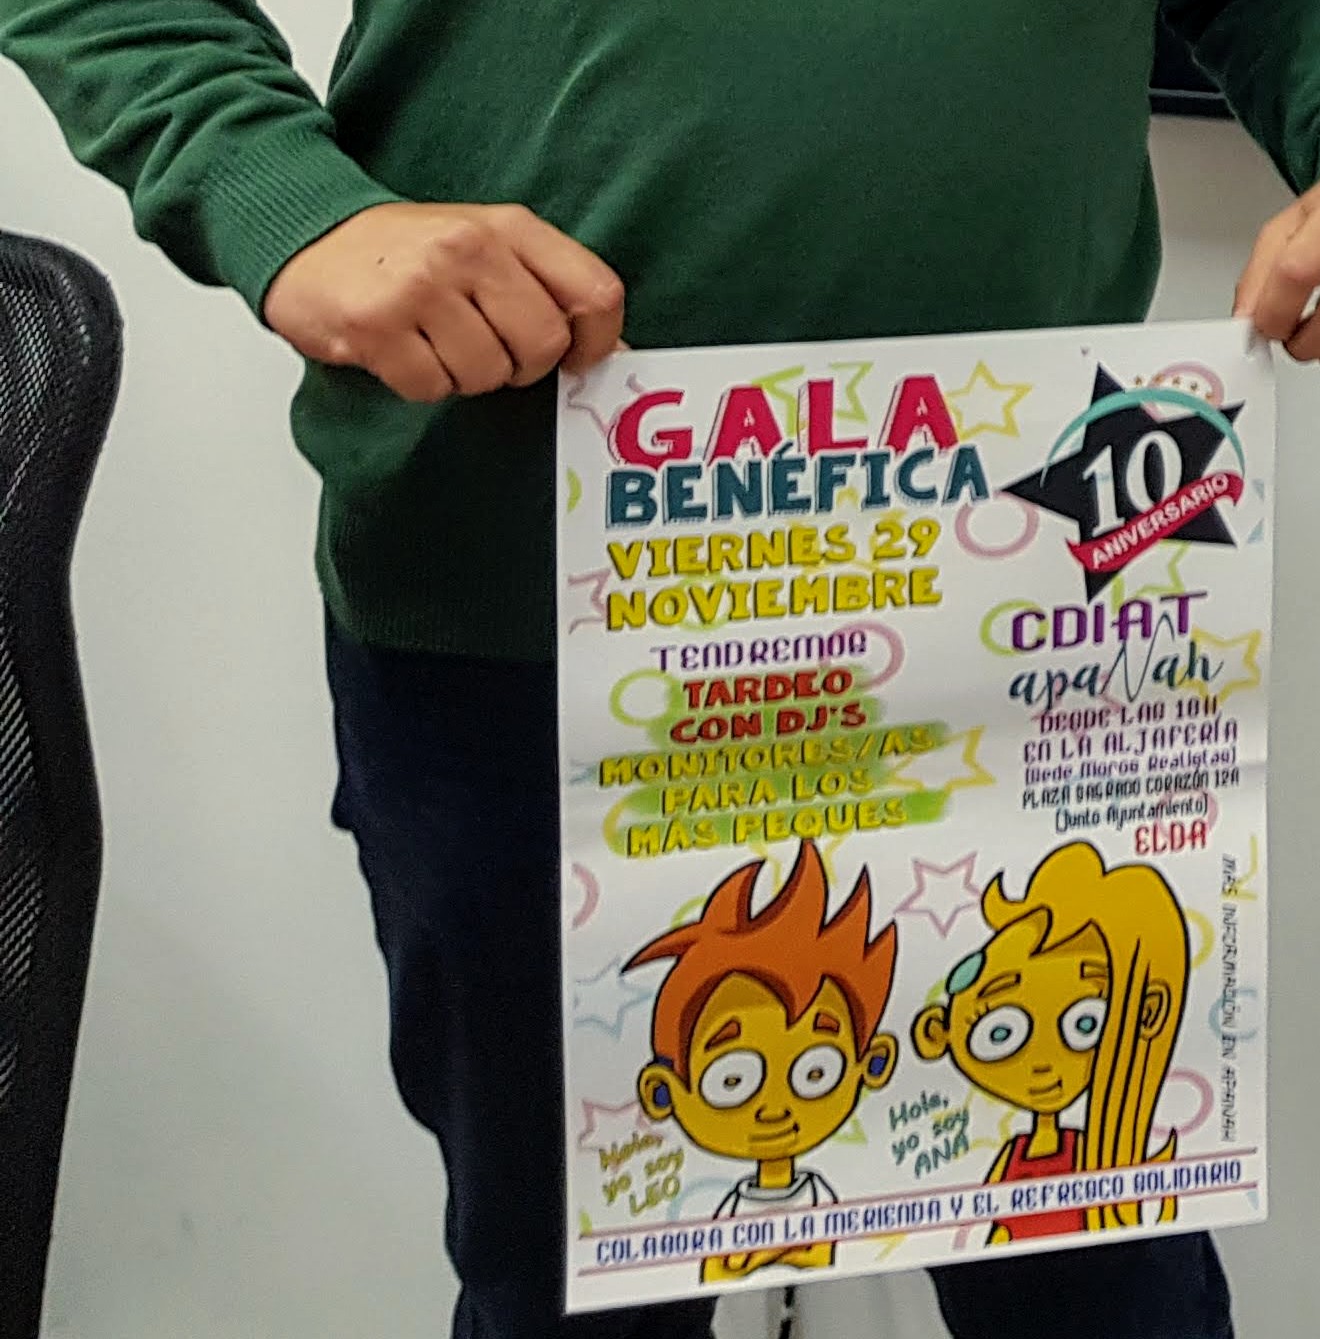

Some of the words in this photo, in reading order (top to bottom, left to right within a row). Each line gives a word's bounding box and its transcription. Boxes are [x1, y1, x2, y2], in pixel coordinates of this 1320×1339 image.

[608, 373, 958, 471] GALA
[606, 440, 991, 528] BENÉFICA
[1084, 431, 1182, 535] 10
[1092, 474, 1229, 568] ANIVERSARIO
[608, 525, 855, 580] VIERNES
[874, 518, 941, 560] 29
[607, 568, 943, 631] NOVIEMBRE
[1012, 592, 1207, 651] CDIAT
[650, 629, 866, 673] TENDREMOS
[683, 669, 852, 709] TARDEO
[670, 713, 762, 744] CON
[777, 702, 866, 736] DJ'S
[600, 725, 936, 787] MONITORES/AS
[1024, 741, 1050, 763] EN
[1061, 736, 1091, 758] LA
[662, 782, 778, 816] PARA
[793, 769, 873, 801] LOS
[734, 799, 907, 844] PEQUES
[1135, 820, 1208, 855] ELDA
[889, 1090, 948, 1131] Hola,
[892, 1134, 919, 1165] yo
[932, 1107, 969, 1136] soy
[914, 1130, 969, 1178] ANA
[630, 1174, 681, 1216] LEO
[733, 1222, 775, 1246] CON
[784, 1216, 815, 1240] LA
[824, 1197, 941, 1234] MERIENDA
[951, 1193, 962, 1220] Y
[973, 1191, 998, 1218] EL
